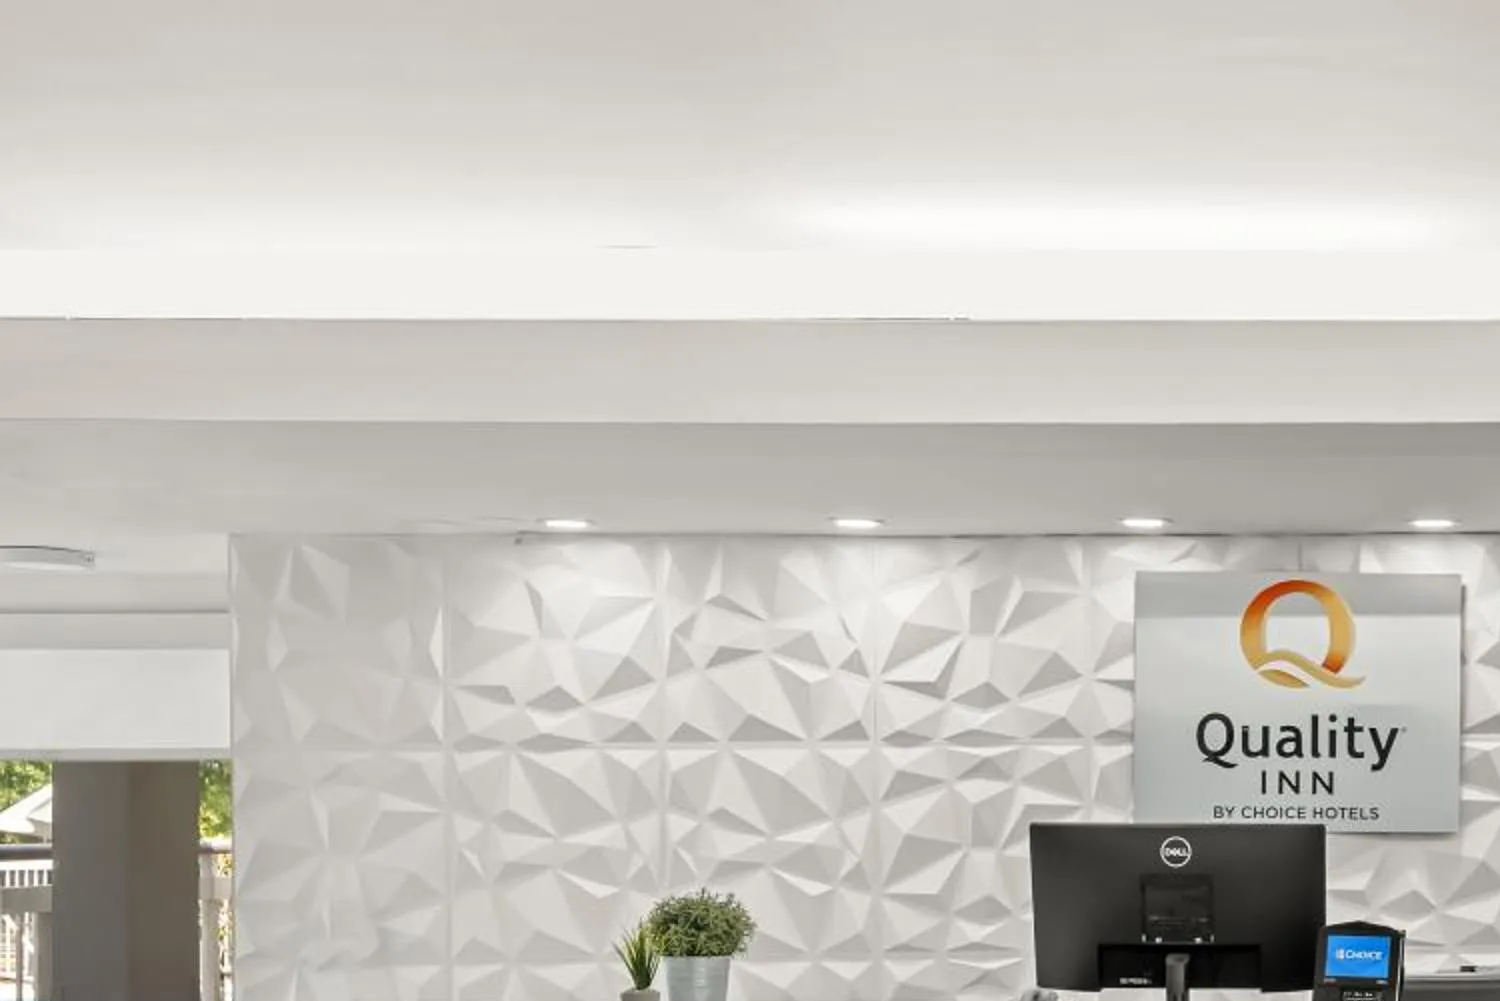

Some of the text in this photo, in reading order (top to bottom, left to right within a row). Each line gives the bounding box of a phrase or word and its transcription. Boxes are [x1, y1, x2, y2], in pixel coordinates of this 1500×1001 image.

[1240, 579, 1366, 689] Q
[1196, 712, 1400, 771] Quality
[1260, 770, 1334, 795] INN
[1213, 805, 1380, 821] BY CHOICE HOTELS
